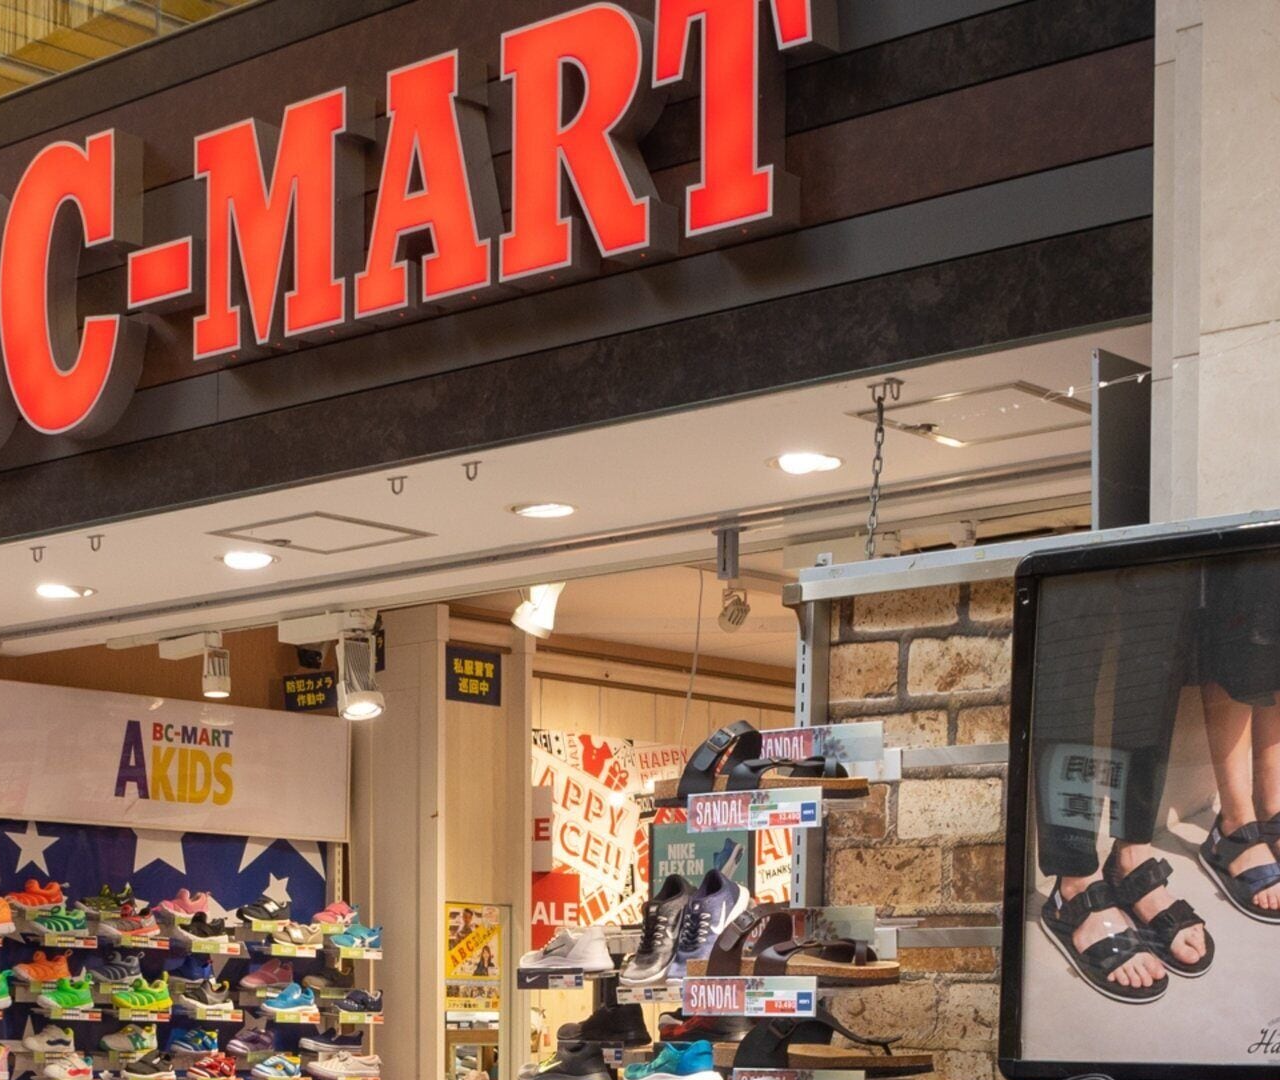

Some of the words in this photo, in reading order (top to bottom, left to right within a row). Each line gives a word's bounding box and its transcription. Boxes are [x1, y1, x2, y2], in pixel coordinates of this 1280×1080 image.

[285, 676, 334, 693] 防犯カメラ
[149, 743, 235, 806] KIDS
[695, 798, 745, 826] SANDAL
[667, 842, 696, 860] NIKE
[658, 860, 686, 876] FLEX
[686, 859, 704, 875] RN
[689, 983, 740, 1011] SANDAL
